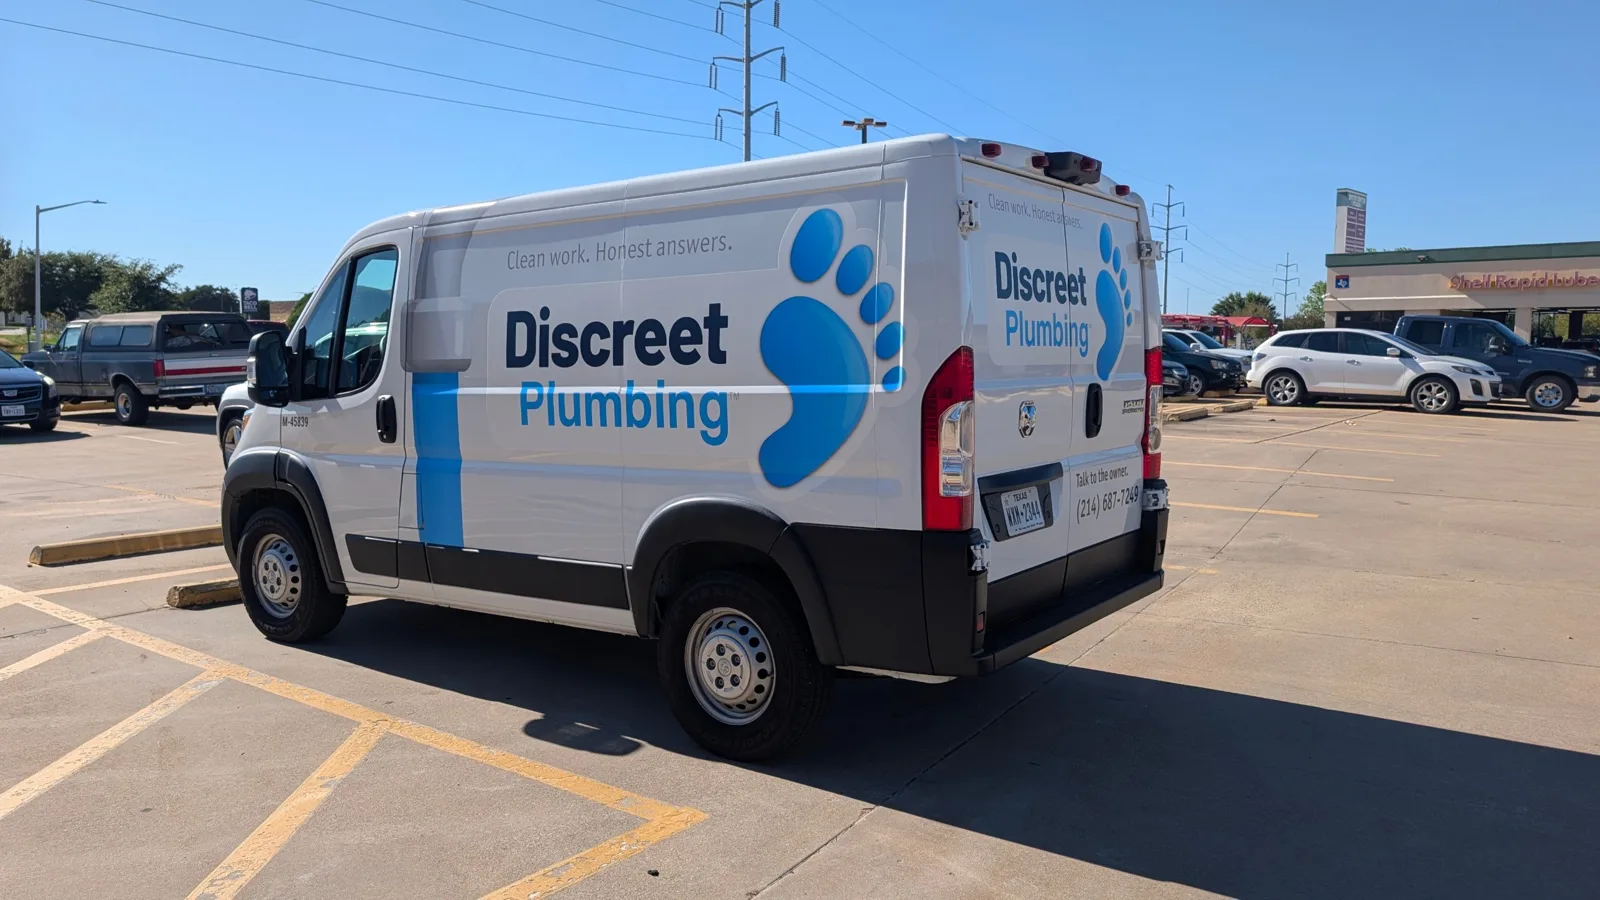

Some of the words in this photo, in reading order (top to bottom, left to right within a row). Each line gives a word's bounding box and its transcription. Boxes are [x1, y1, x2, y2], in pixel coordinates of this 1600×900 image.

[987, 193, 1010, 213] Clean
[1010, 202, 1031, 218] work.
[1031, 204, 1057, 224] Honest
[507, 249, 546, 270] Clean
[549, 243, 590, 264] work.
[596, 238, 652, 262] Honest
[656, 234, 733, 257] answers.
[994, 251, 1087, 307] Discreet
[1449, 274, 1492, 291] Shell
[1495, 272, 1549, 292] Rapid
[1552, 270, 1600, 289] Lube
[506, 303, 729, 369] Discreet
[1005, 310, 1089, 358] Plumbing
[282, 416, 309, 428] M-45839
[519, 379, 729, 446] Plumbing
[1076, 472, 1090, 488] Talk
[1090, 471, 1097, 485] to
[1098, 467, 1109, 483] the
[1109, 466, 1129, 480] owner.
[1012, 491, 1028, 502] TEXAS
[1076, 493, 1101, 525] (214)
[1102, 485, 1139, 512] 687-7249
